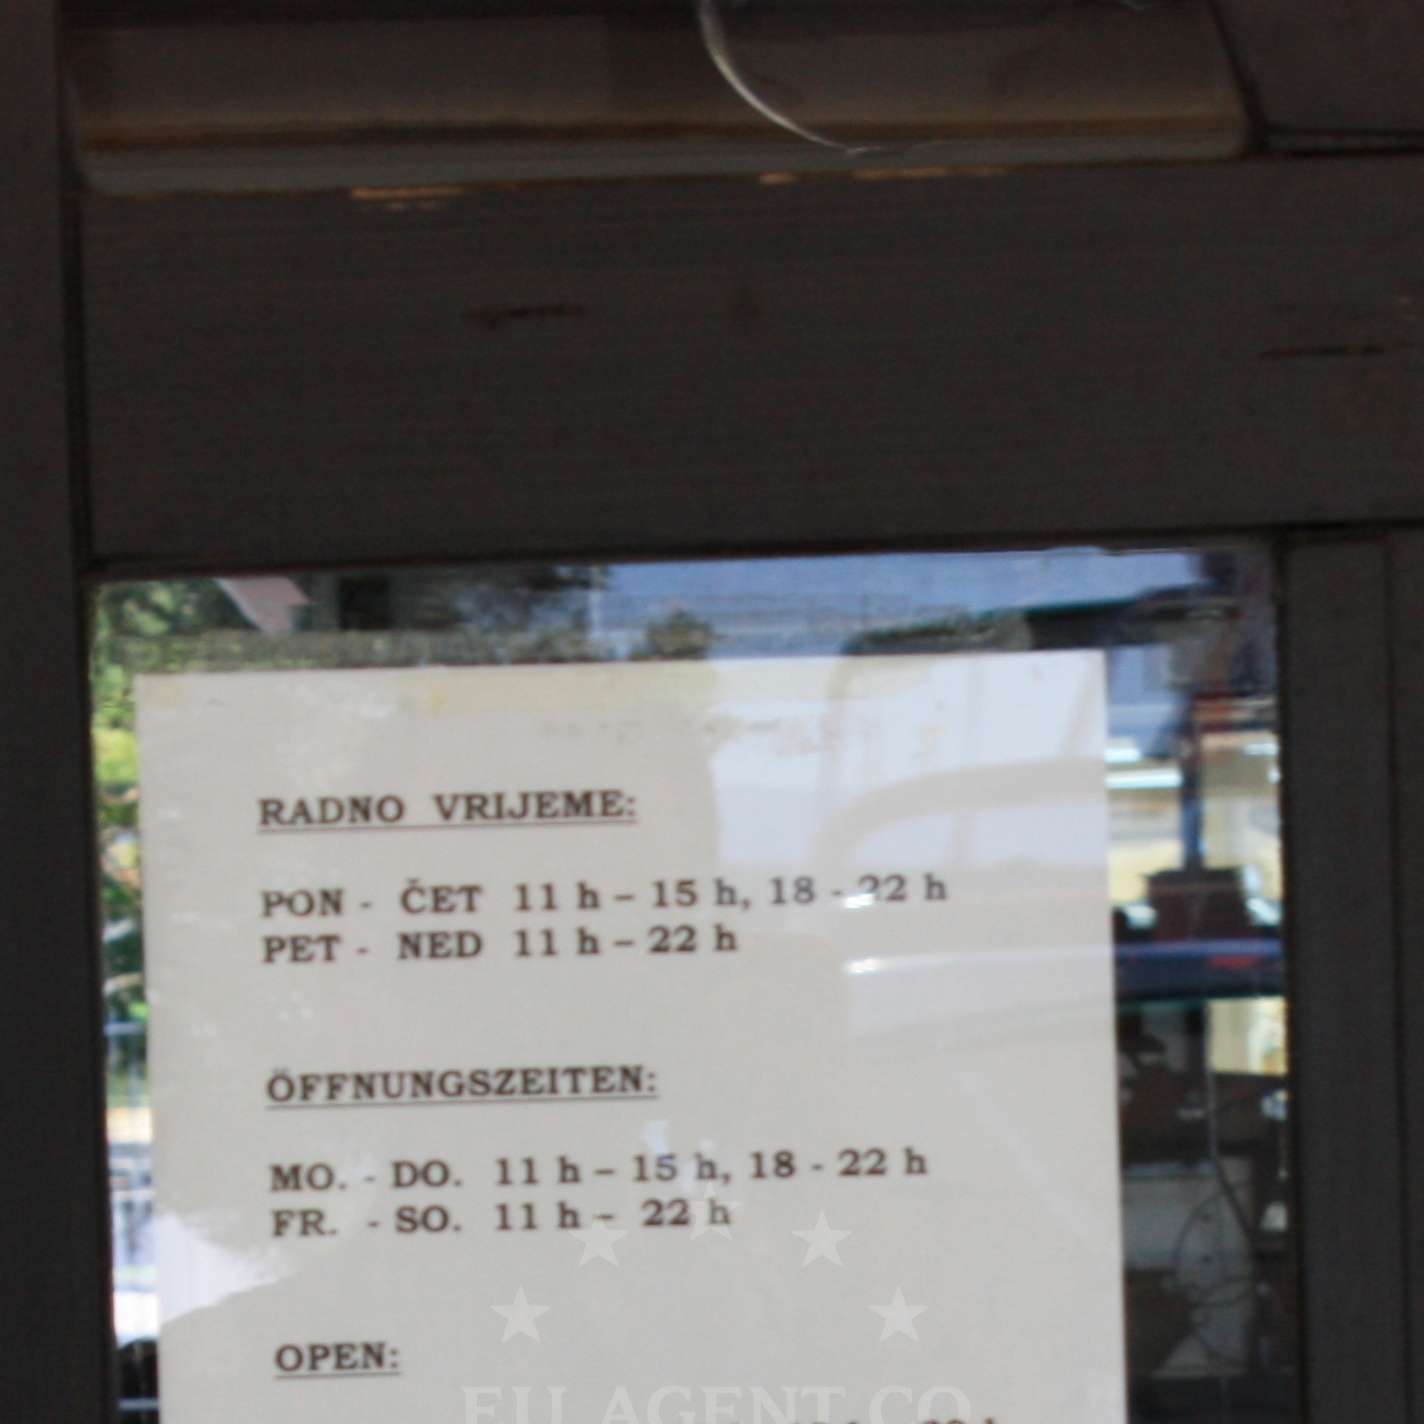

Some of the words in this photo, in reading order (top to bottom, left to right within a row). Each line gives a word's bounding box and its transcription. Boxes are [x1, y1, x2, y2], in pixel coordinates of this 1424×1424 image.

[258, 793, 406, 827] RADNO
[433, 789, 637, 821] VRIJEME:
[261, 888, 344, 918] PON
[400, 878, 484, 914] ČET
[653, 879, 698, 908] 15
[770, 876, 816, 905] 18
[858, 874, 908, 902] 22
[262, 934, 343, 964] PET
[398, 930, 484, 960] NED
[649, 925, 697, 953] 22
[266, 1065, 657, 1102] ÖFFNUNGSZEITEN:
[269, 1163, 347, 1193] MO.
[391, 1160, 463, 1189] DO.
[633, 1152, 678, 1182] 15
[750, 1150, 796, 1179] 18
[837, 1148, 888, 1177] 22
[272, 1208, 338, 1238] FR.
[395, 1204, 463, 1234] SO.
[641, 1198, 691, 1227] 22
[275, 1342, 400, 1373] OPEN:
